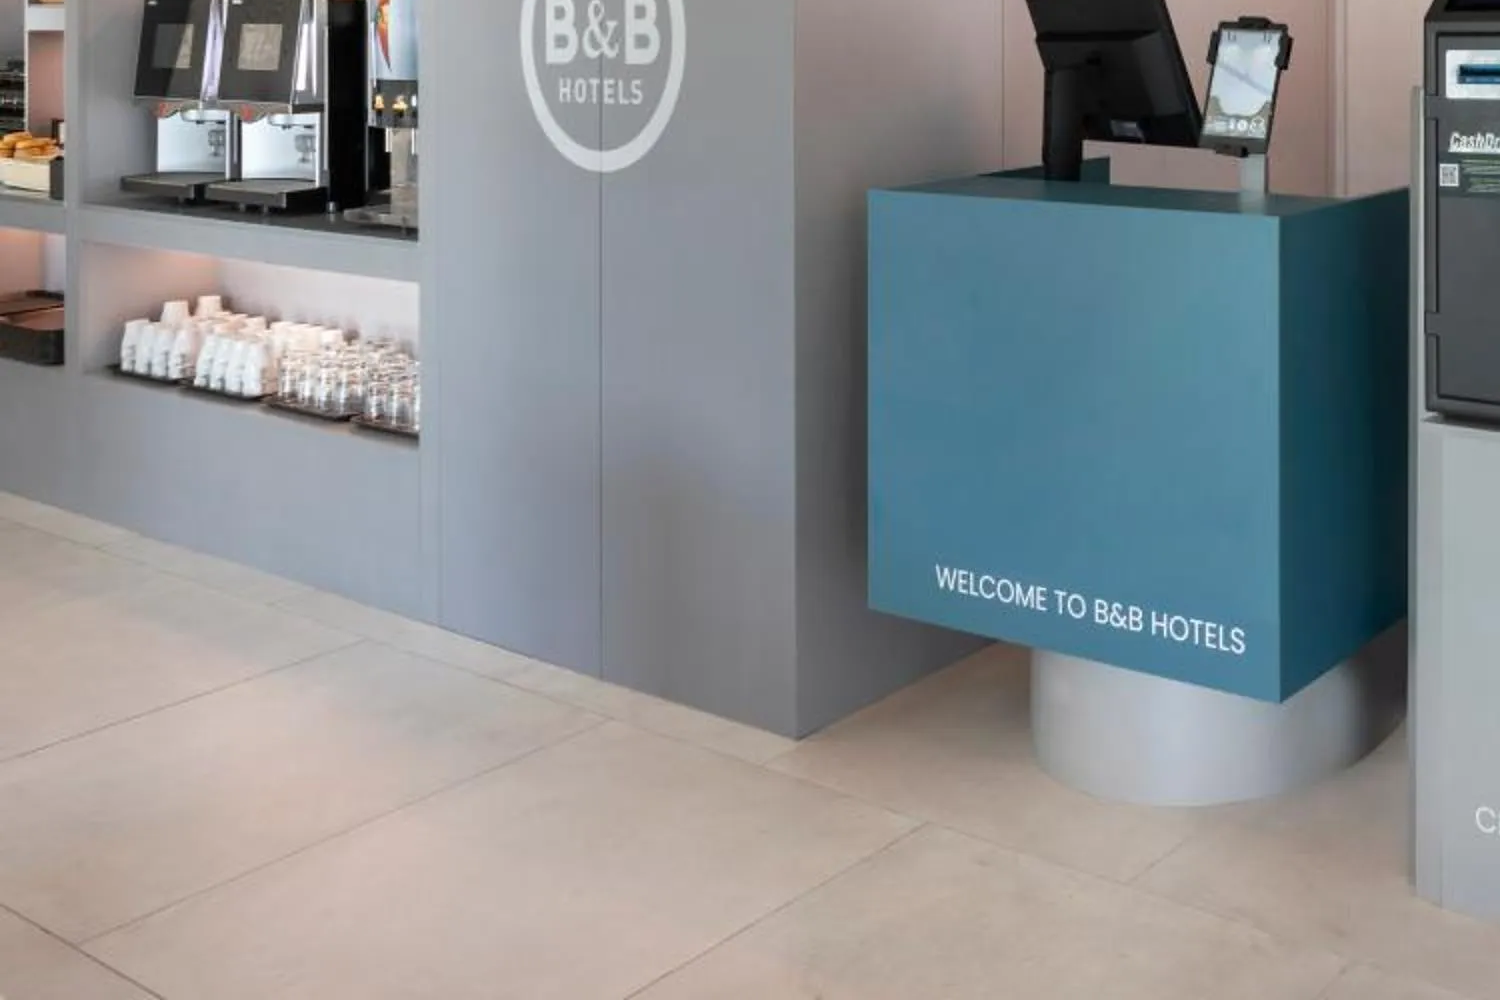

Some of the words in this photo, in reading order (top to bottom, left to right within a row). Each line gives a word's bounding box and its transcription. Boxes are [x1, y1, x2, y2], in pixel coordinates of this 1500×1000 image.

[558, 77, 643, 104] HOTELS
[935, 563, 1048, 612] WELCOME
[1053, 589, 1087, 619] TO
[1094, 598, 1143, 632] B&B
[1151, 610, 1247, 655] HOTELS
